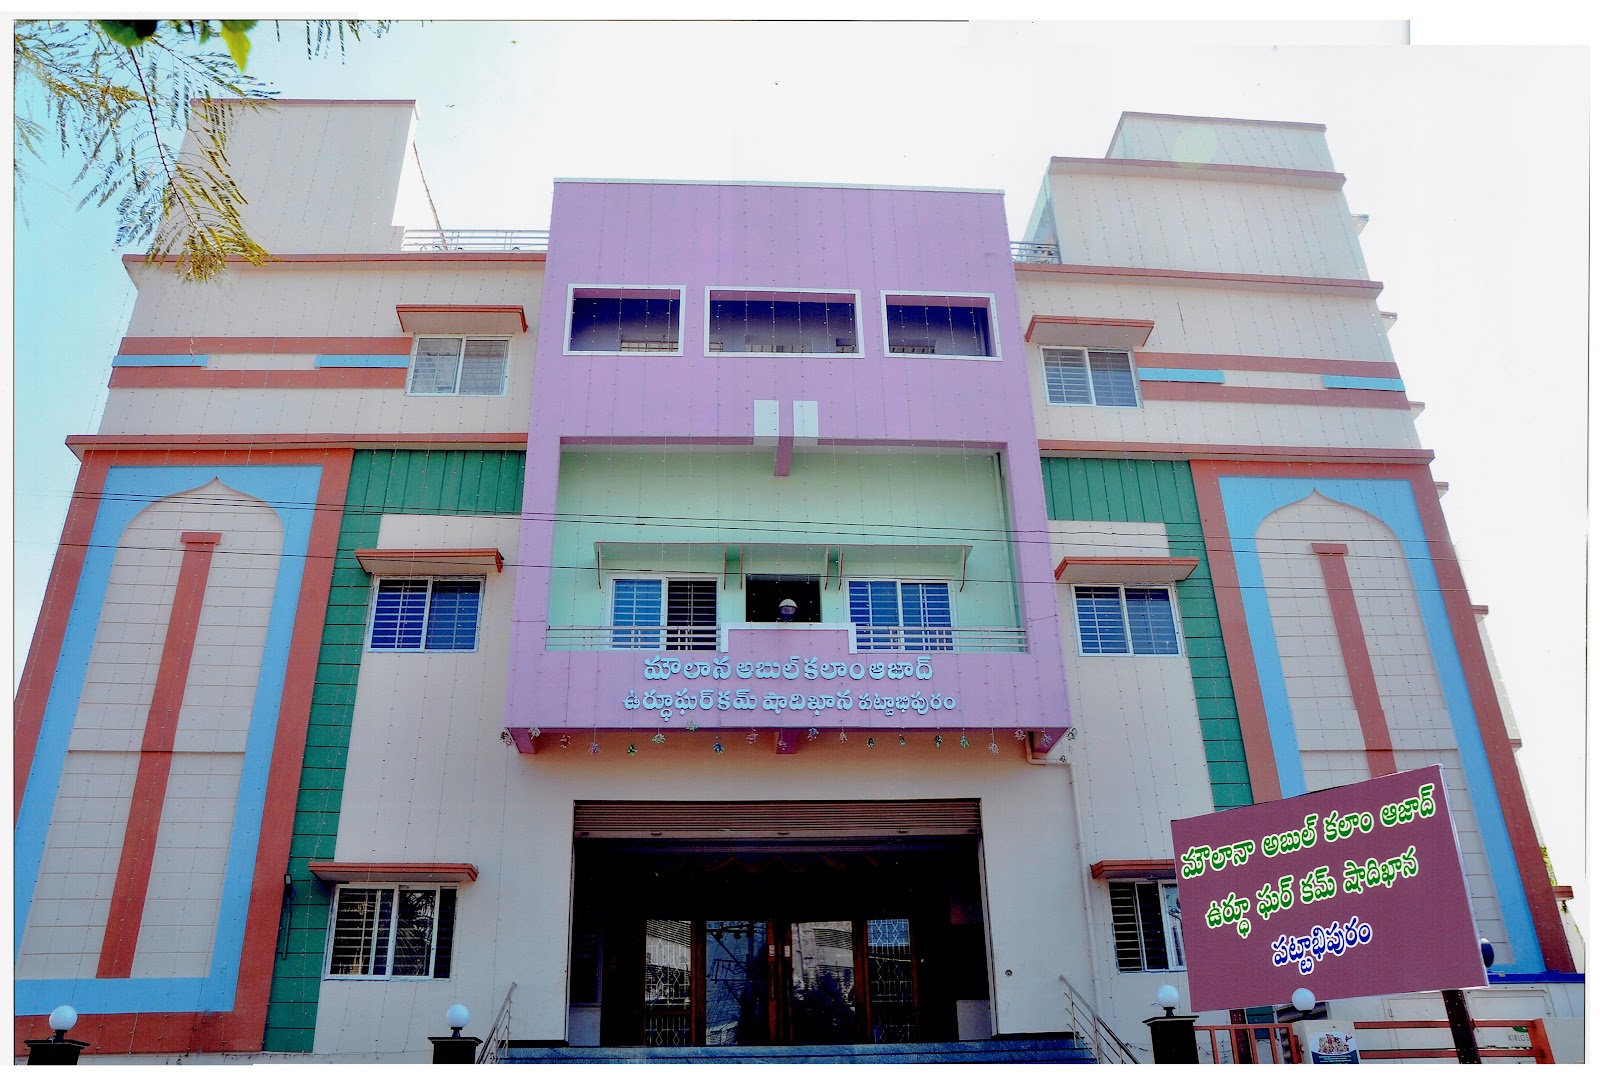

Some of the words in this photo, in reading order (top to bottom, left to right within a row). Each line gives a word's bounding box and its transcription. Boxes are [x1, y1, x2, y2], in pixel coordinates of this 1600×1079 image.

[1261, 813, 1319, 857] అబుల్
[1323, 810, 1374, 842] కలాం
[1381, 782, 1436, 827] ఆజాద్
[1300, 866, 1337, 904] కమ్
